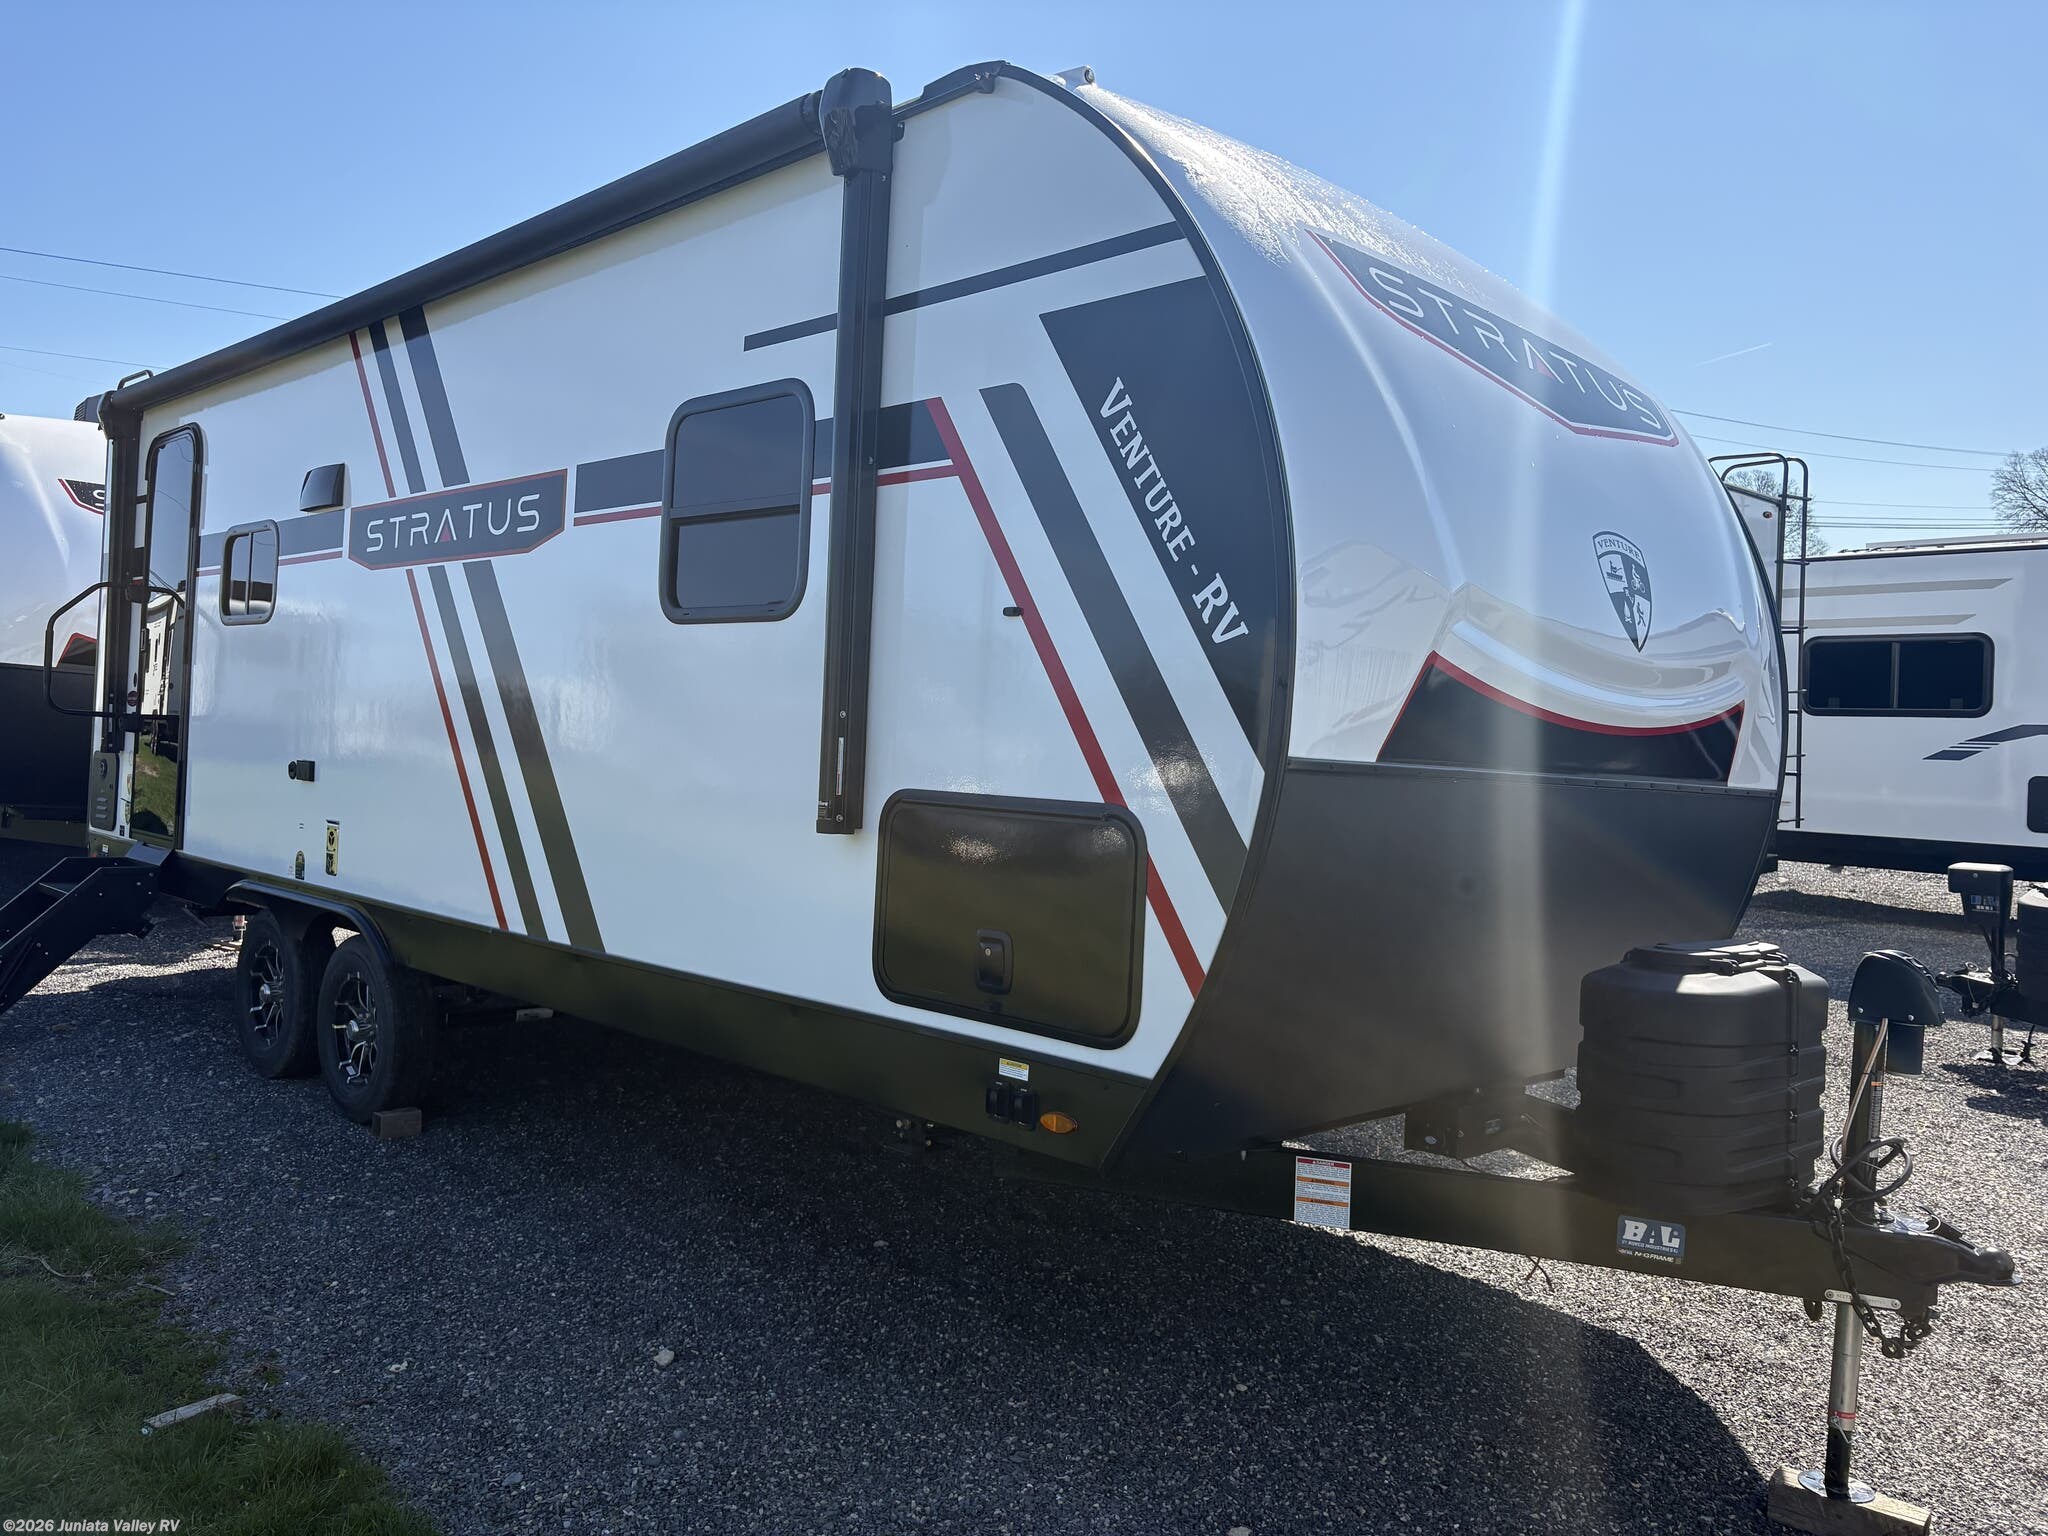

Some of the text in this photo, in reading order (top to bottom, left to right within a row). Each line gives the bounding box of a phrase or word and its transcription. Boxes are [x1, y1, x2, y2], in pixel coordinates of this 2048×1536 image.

[1369, 267, 1661, 429] STRATUS
[366, 494, 540, 552] STRATUS
[1597, 537, 1642, 562] VENTURE
[1192, 572, 1249, 644] RV
